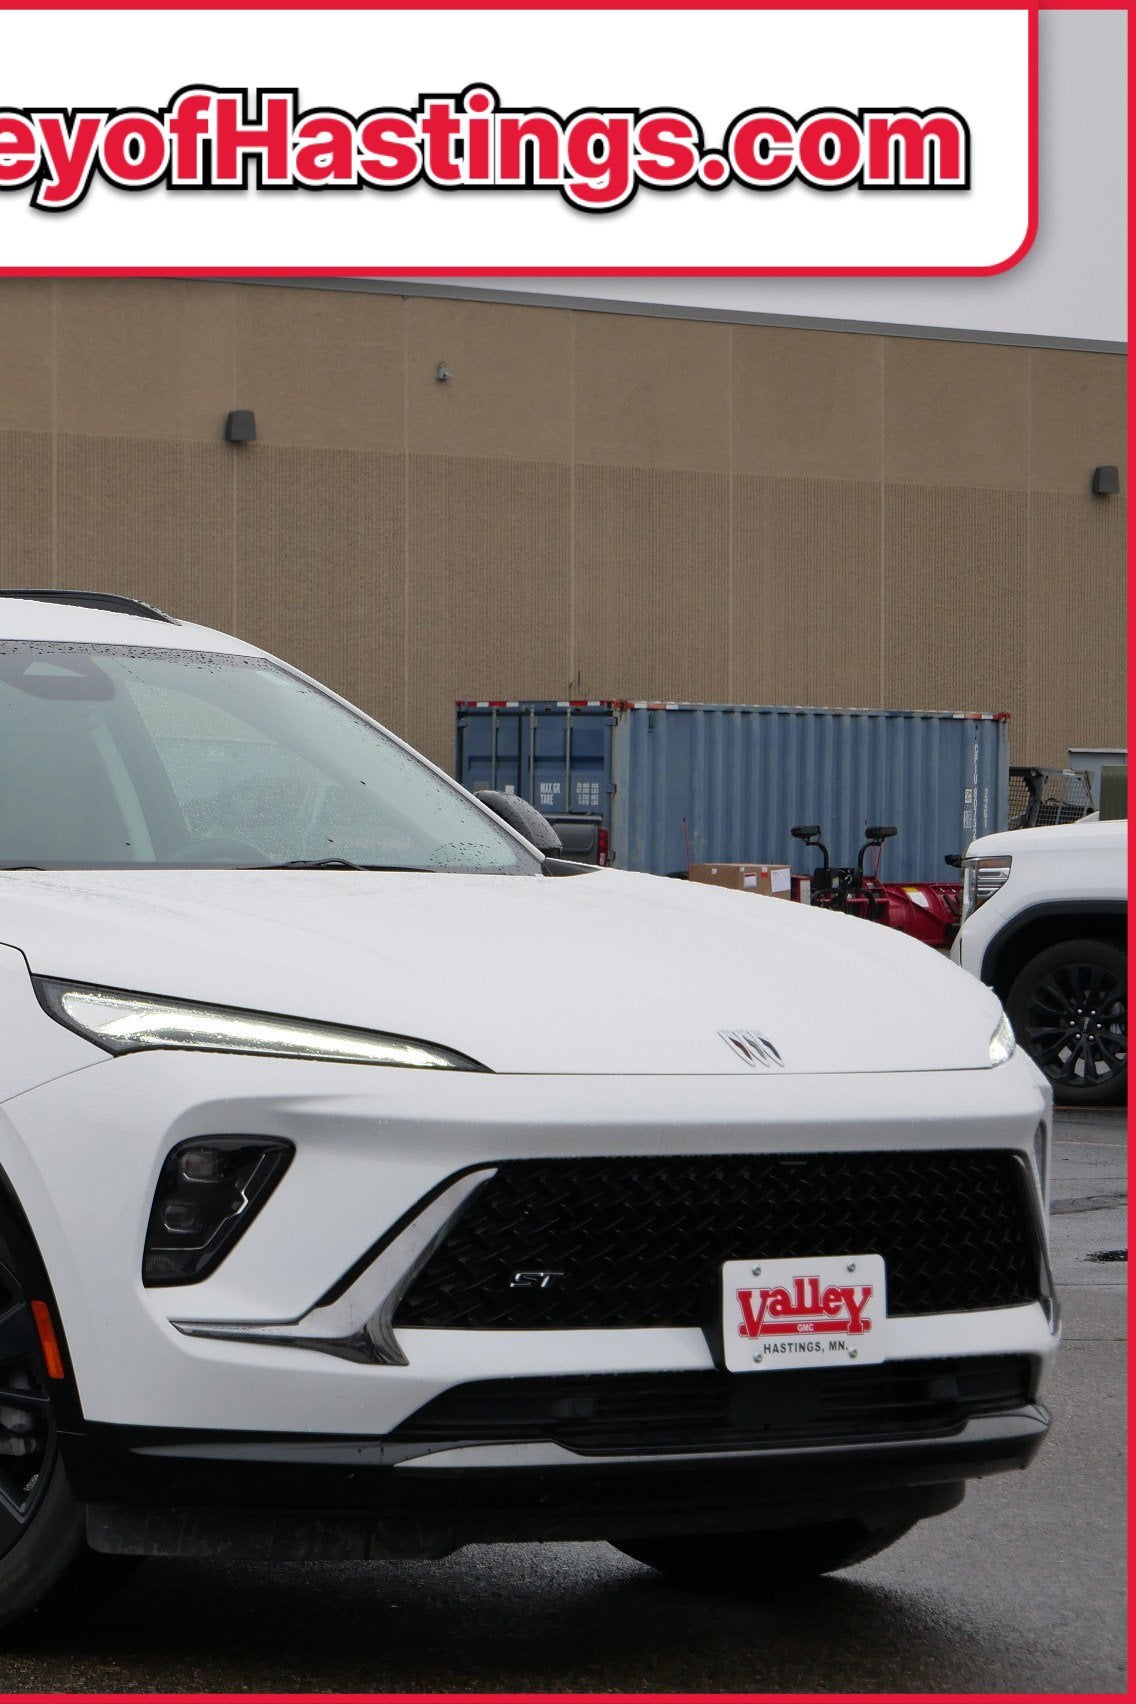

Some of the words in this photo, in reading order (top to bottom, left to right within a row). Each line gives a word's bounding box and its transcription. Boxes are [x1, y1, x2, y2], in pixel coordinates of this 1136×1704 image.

[509, 1271, 565, 1288] ST
[737, 1276, 873, 1340] Valley
[797, 1322, 814, 1333] GMC
[763, 1341, 825, 1355] HASTINGS,
[829, 1340, 849, 1352] MN.
